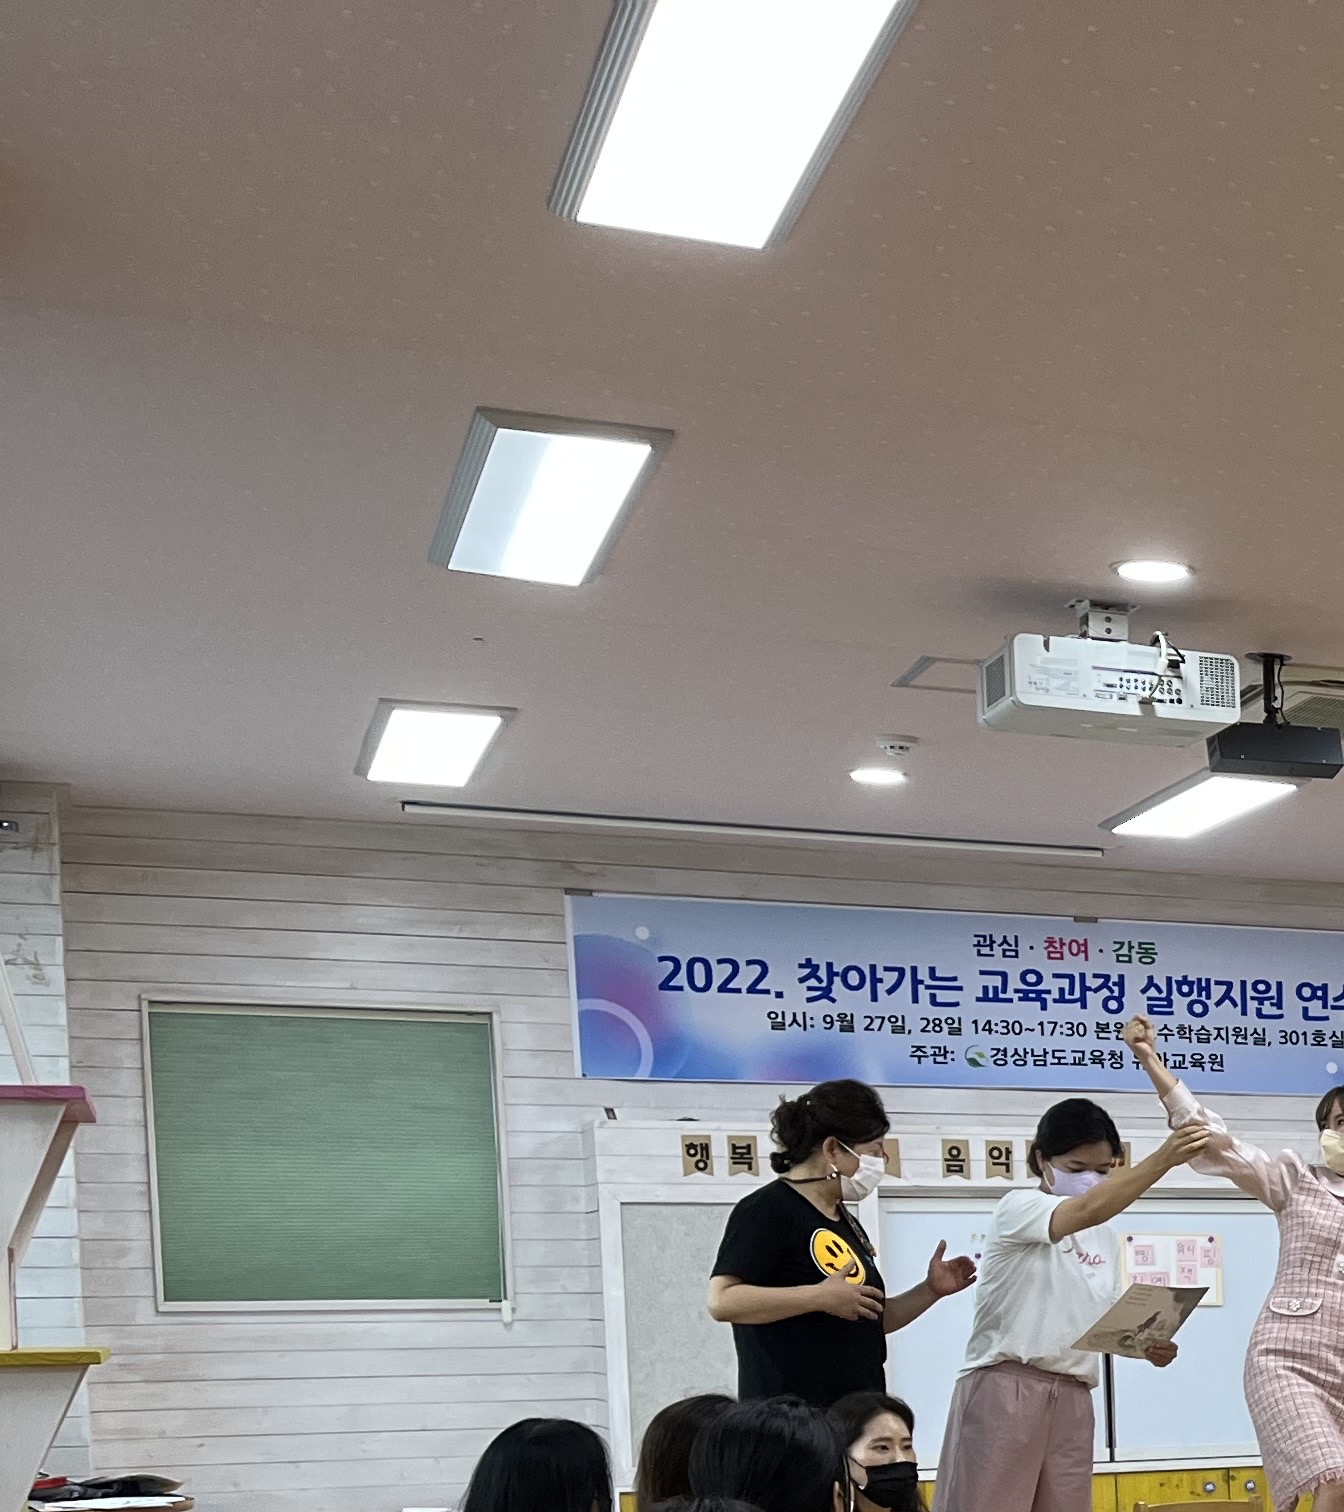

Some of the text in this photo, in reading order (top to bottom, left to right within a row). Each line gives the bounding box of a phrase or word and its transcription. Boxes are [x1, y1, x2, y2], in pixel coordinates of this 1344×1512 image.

[972, 933, 1158, 965] 관심 참여 감동
[657, 955, 784, 999] 2022.
[797, 957, 964, 1008] 찾아가는
[975, 968, 1127, 1015] 교육과정
[1139, 973, 1285, 1020] 실행지원
[767, 1010, 815, 1031] 일시:
[822, 1012, 855, 1033] 9월
[863, 1014, 912, 1035] 27일,
[919, 1016, 963, 1037] 28일
[971, 1019, 1087, 1038] 14:30~17:30
[1152, 1023, 1272, 1047] 수학습지원실,
[1278, 1029, 1344, 1049] 301호실
[909, 1044, 955, 1065] 주관:
[990, 1046, 1124, 1070] 경상남도교육청
